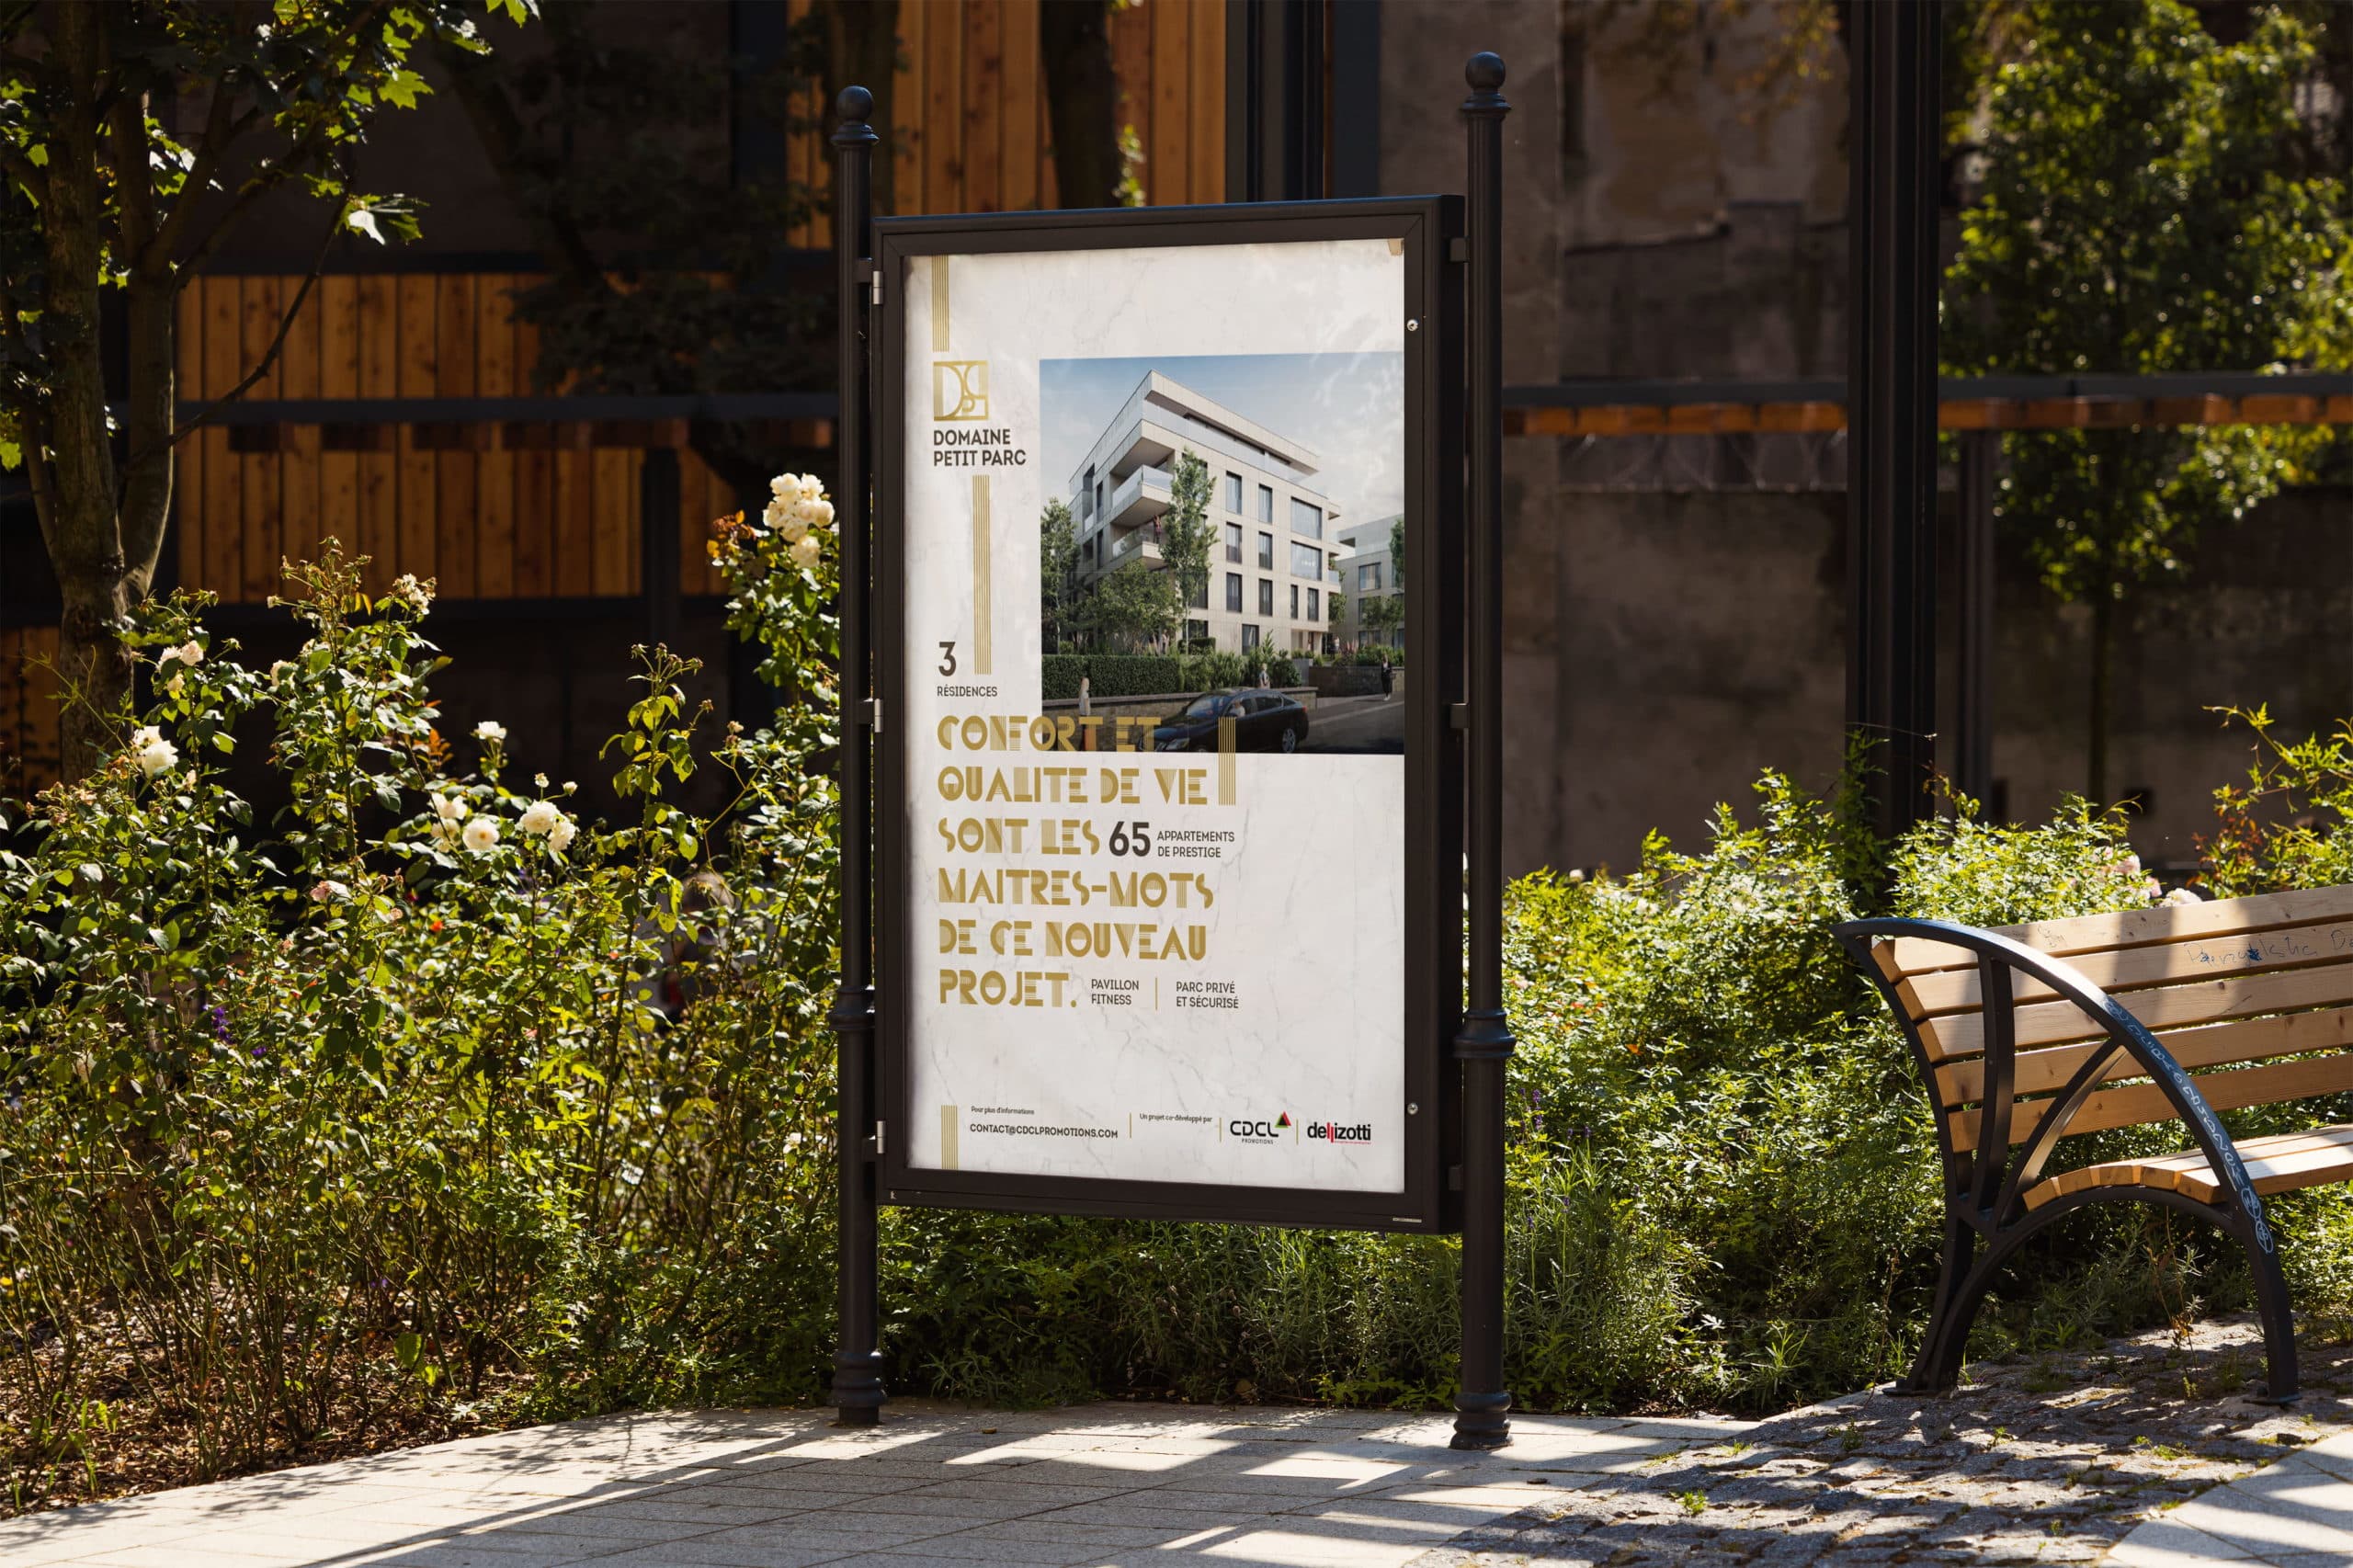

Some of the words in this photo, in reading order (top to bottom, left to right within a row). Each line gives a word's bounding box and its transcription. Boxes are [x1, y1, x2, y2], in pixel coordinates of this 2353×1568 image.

[933, 428, 1011, 446] DOMAINE
[934, 449, 978, 467] PETIT
[982, 449, 1027, 466] PARC
[938, 642, 957, 676] 3
[937, 684, 998, 697] RÉSIDENCES
[938, 715, 1103, 751] CONFORT
[1116, 716, 1161, 752] ET
[938, 766, 1087, 802] QUALITE
[1101, 767, 1140, 804] DE
[1154, 768, 1208, 805] VIE
[938, 817, 1029, 854] SONT
[1041, 818, 1100, 856] LES
[1108, 820, 1151, 857] 65
[1156, 831, 1234, 843] APPARTEMENTS
[1157, 846, 1170, 858] DE
[1173, 846, 1222, 858] PRESTIGE
[938, 868, 1213, 909] MAITRES-MOTS
[939, 919, 976, 956] DE
[990, 920, 1033, 956] CE
[1046, 922, 1206, 960] NOUVEAU
[939, 969, 1077, 1008] PROJET.
[1091, 978, 1140, 991] PAVILLON
[1176, 981, 1203, 993] PARC
[1205, 980, 1235, 994] PRIVÉ
[1091, 994, 1132, 1006] FITNESS
[1176, 996, 1188, 1007] ET
[1189, 995, 1239, 1009] SÉCURISÉ
[970, 1123, 1119, 1139] CONTACT@CDCLPROMOTIONS.COM
[1230, 1120, 1279, 1137] CDCL
